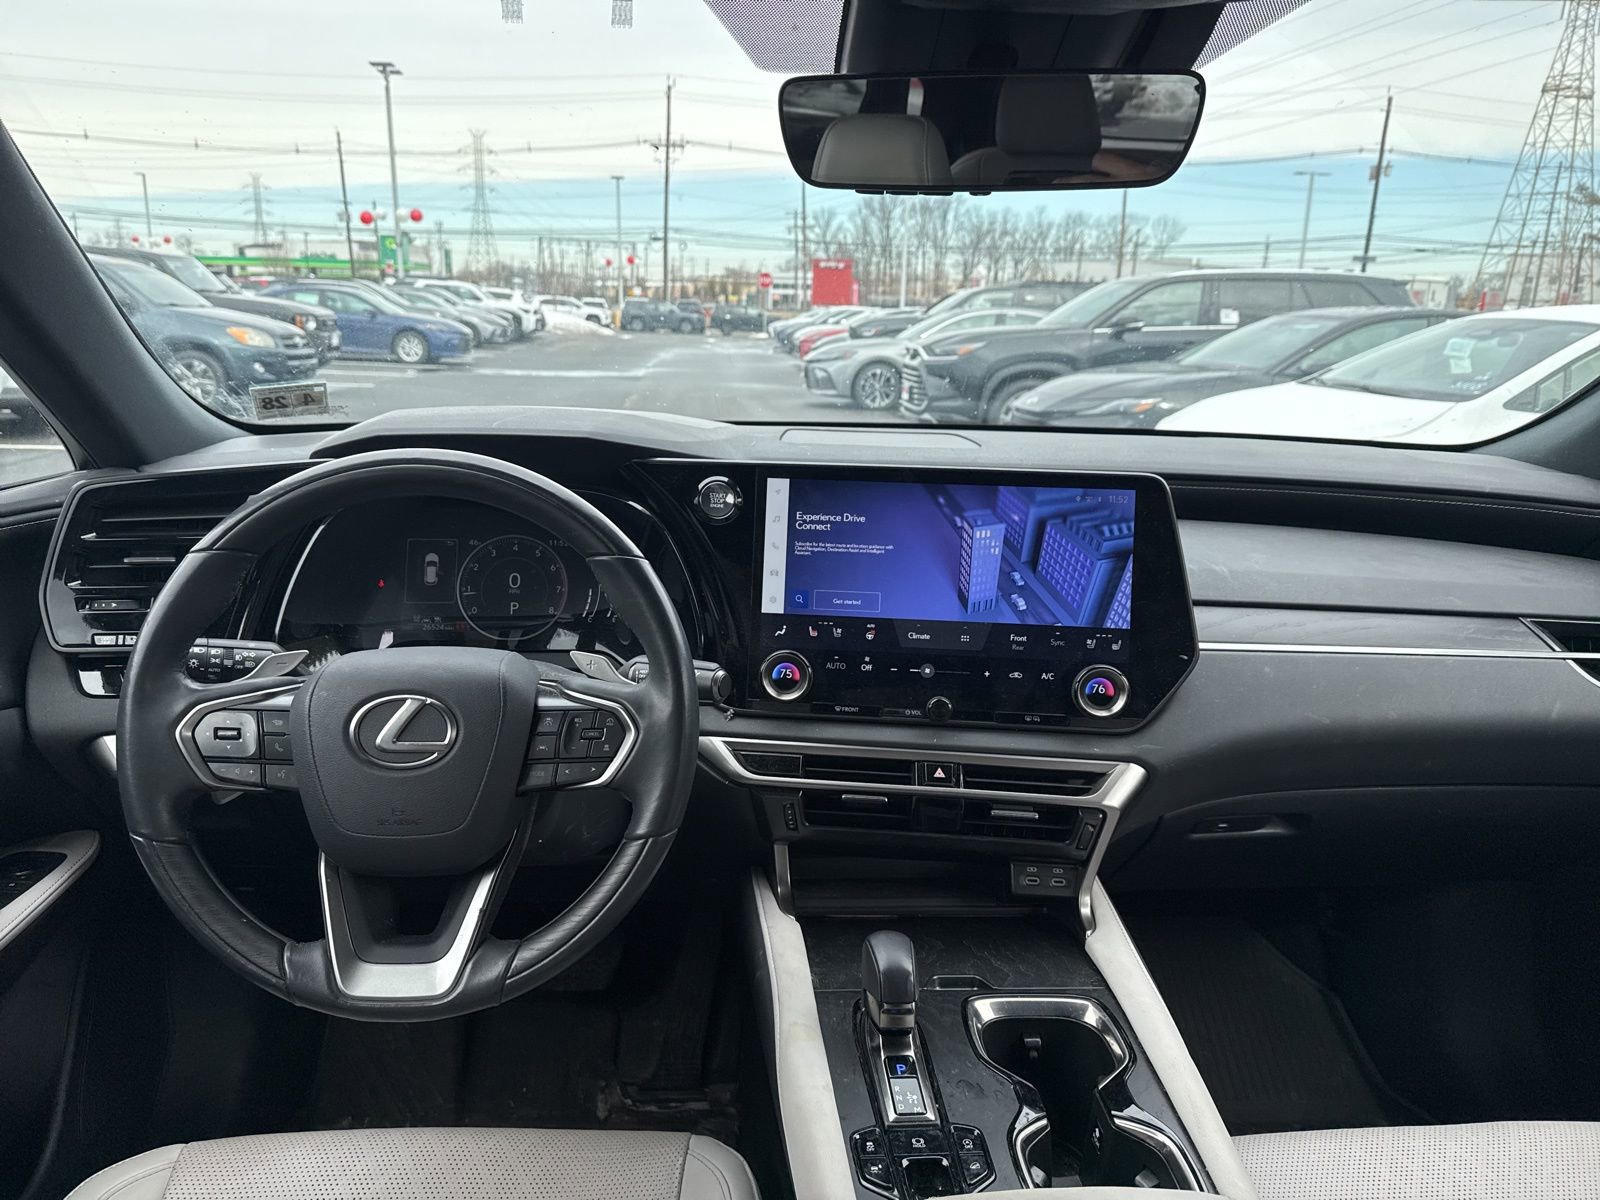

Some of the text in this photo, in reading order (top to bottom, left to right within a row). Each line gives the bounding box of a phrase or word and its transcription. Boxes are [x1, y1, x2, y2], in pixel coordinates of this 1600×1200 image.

[1109, 495, 1129, 504] 11:52
[796, 511, 866, 523] Experience Drive
[795, 520, 831, 531] Connect
[512, 544, 519, 552] 4
[550, 564, 556, 572] 6
[508, 572, 521, 589] 0
[555, 585, 562, 593] 7
[471, 606, 478, 614] 0
[510, 602, 519, 615] P
[549, 606, 555, 614] 8
[907, 631, 931, 640] Climate
[1010, 634, 1027, 642] Front
[1050, 638, 1065, 647] Sync
[825, 662, 847, 670] AUTO
[860, 663, 873, 672] Off
[779, 668, 793, 679] 75
[1041, 672, 1055, 681] A/C
[1092, 683, 1106, 694] 76
[895, 1063, 907, 1075] P
